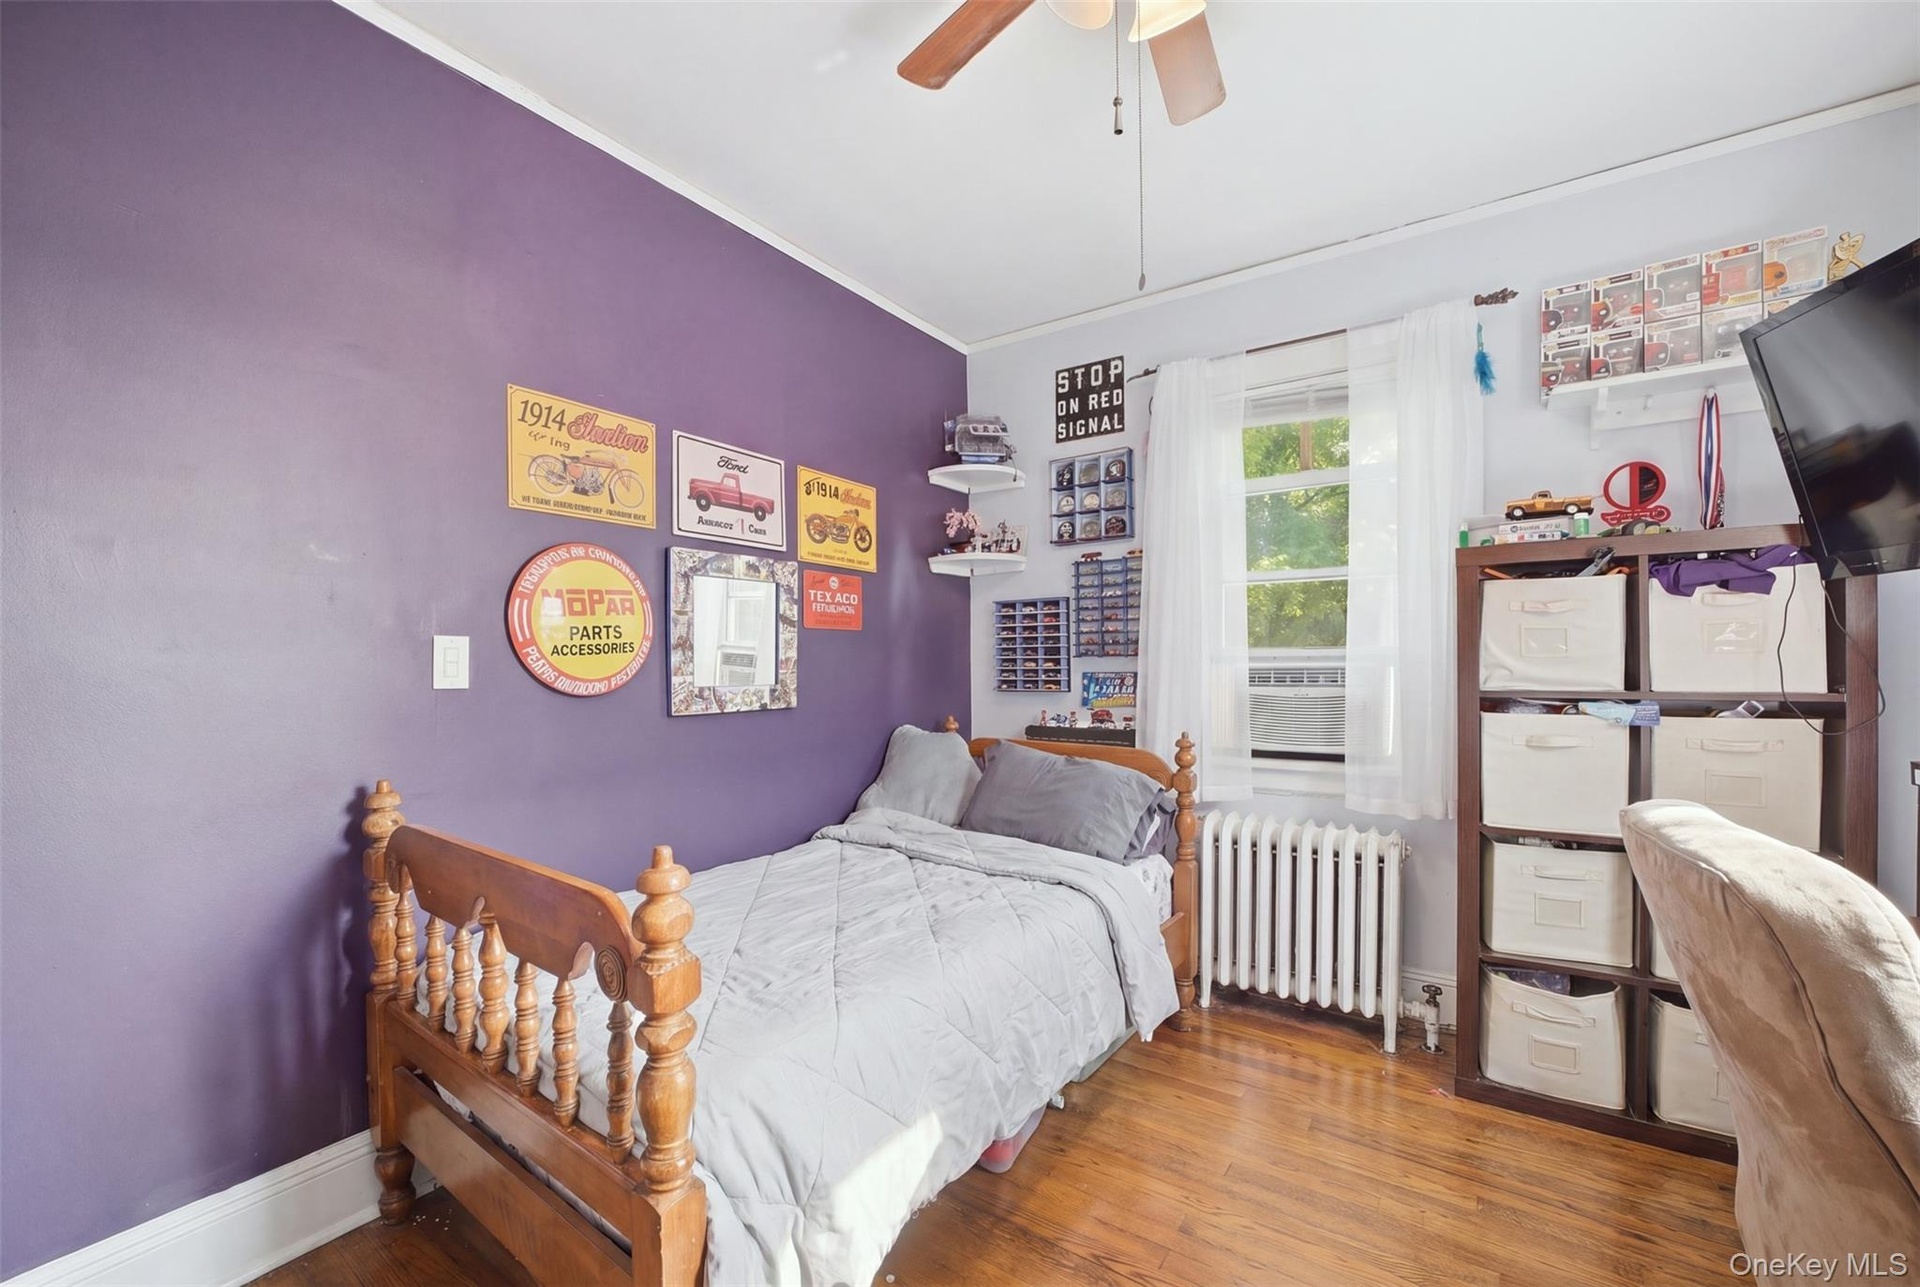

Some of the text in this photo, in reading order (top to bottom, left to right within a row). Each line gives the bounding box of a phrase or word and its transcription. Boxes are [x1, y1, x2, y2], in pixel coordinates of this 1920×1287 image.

[1057, 359, 1123, 393] STOP
[518, 399, 567, 432] 1914
[1057, 389, 1123, 416] ON RED
[1057, 413, 1123, 439] SIGNAL
[569, 624, 623, 641] PARTS
[551, 641, 635, 656] ACCESSORIES
